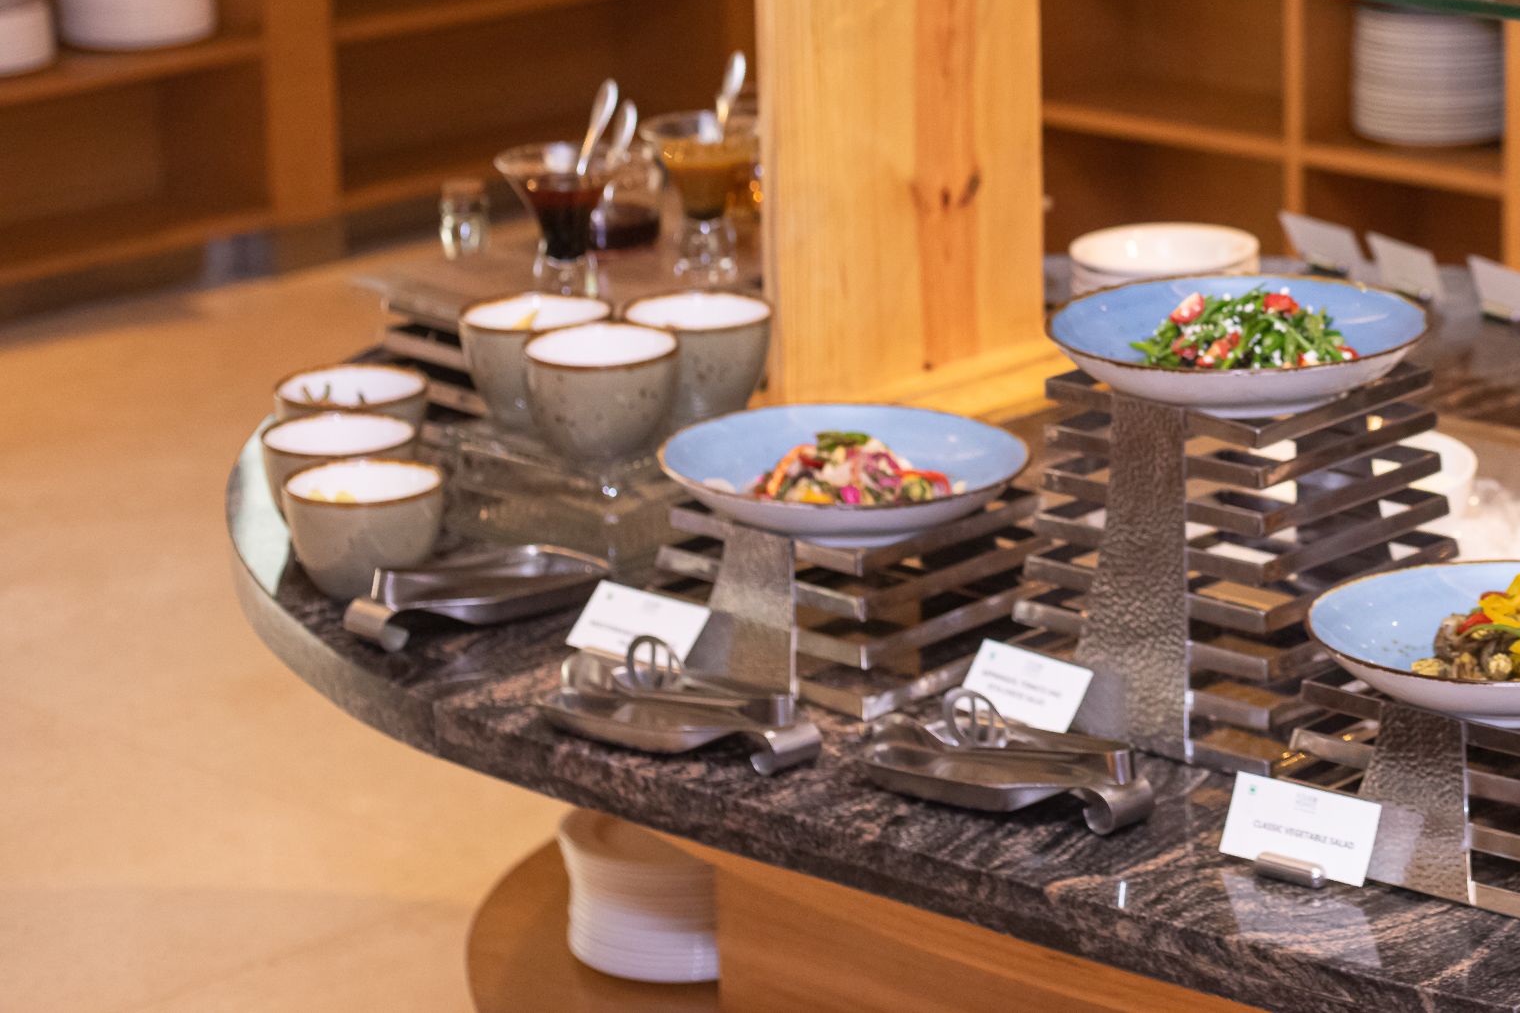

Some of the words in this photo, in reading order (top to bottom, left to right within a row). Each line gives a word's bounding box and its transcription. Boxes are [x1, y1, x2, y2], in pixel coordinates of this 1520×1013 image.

[1252, 819, 1283, 835] CLASSIC
[1284, 827, 1328, 845] VEGETABLE
[1329, 837, 1356, 850] SALAD
